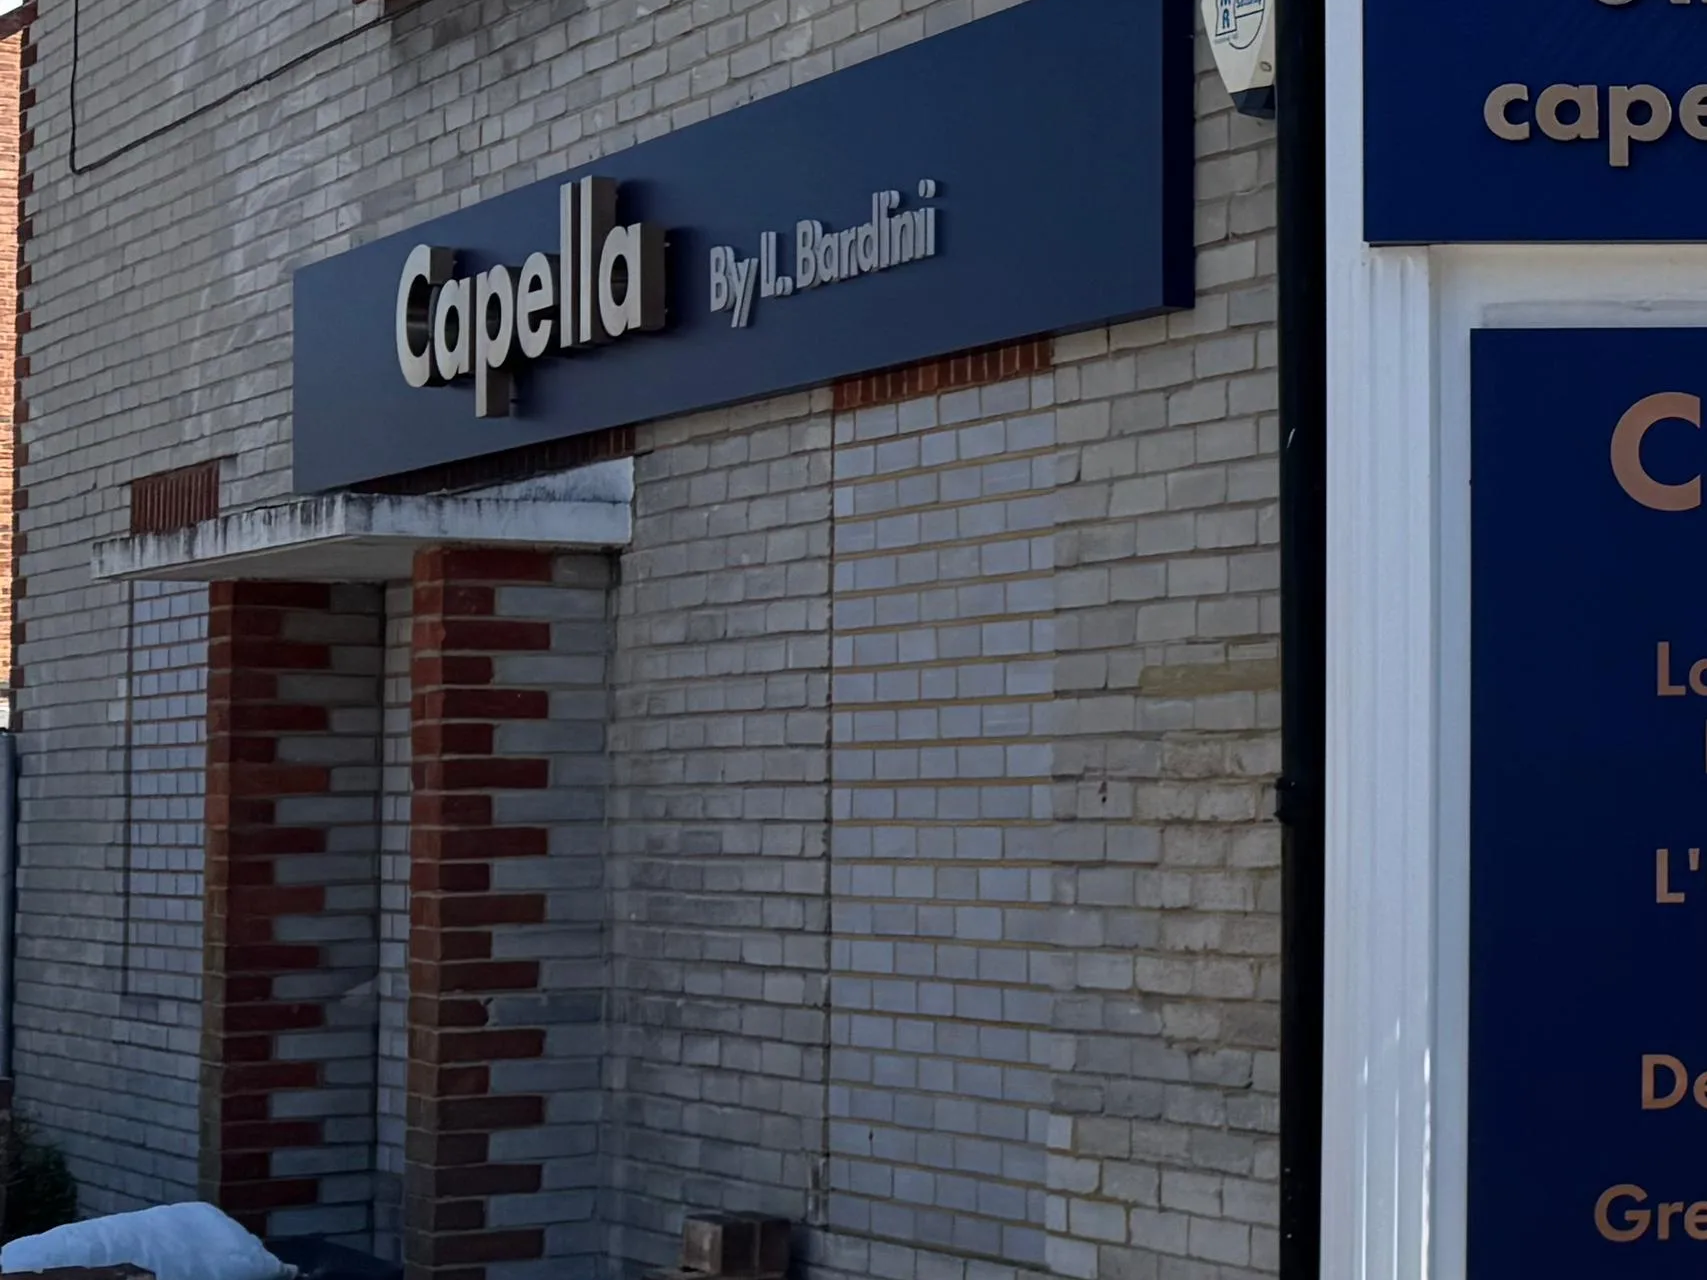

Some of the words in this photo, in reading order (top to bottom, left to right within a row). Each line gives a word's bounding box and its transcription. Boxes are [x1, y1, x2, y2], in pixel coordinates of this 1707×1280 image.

[396, 176, 665, 417] Capella
[710, 245, 758, 328] By
[760, 231, 793, 297] L.
[796, 179, 936, 290] Bardini
